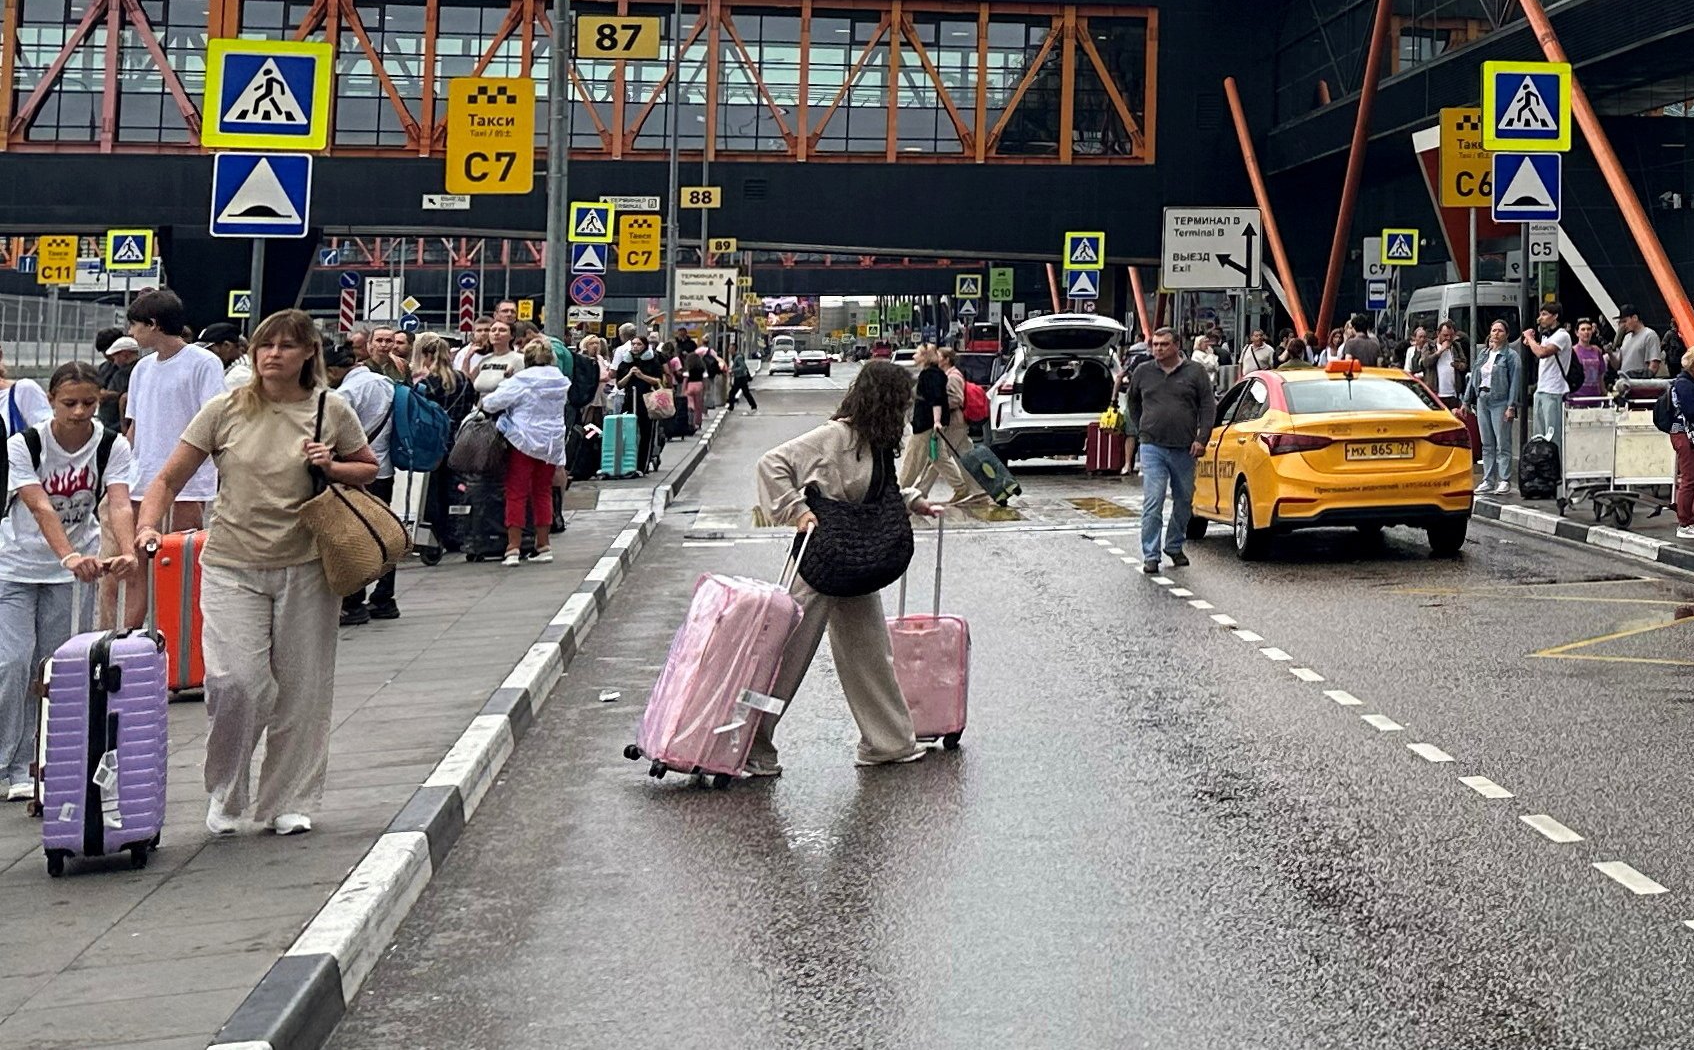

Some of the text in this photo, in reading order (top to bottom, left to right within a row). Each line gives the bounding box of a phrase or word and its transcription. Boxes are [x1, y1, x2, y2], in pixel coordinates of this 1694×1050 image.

[595, 24, 642, 51] 87
[468, 113, 515, 127] Такси
[464, 152, 517, 183] C7
[1456, 171, 1492, 197] C6
[689, 191, 713, 204] 88
[1174, 216, 1231, 225] ТЕРМИНАЛ
[1174, 229, 1225, 237] Terminal B
[715, 241, 731, 250] 89
[1531, 242, 1551, 256] C5
[627, 251, 652, 266] C7
[1172, 253, 1210, 262] ВЫЕЗД
[41, 265, 71, 280] C11
[1172, 264, 1191, 273] Exit
[1369, 263, 1386, 275] C9
[992, 288, 1011, 298] C10
[1371, 443, 1393, 456] 865
